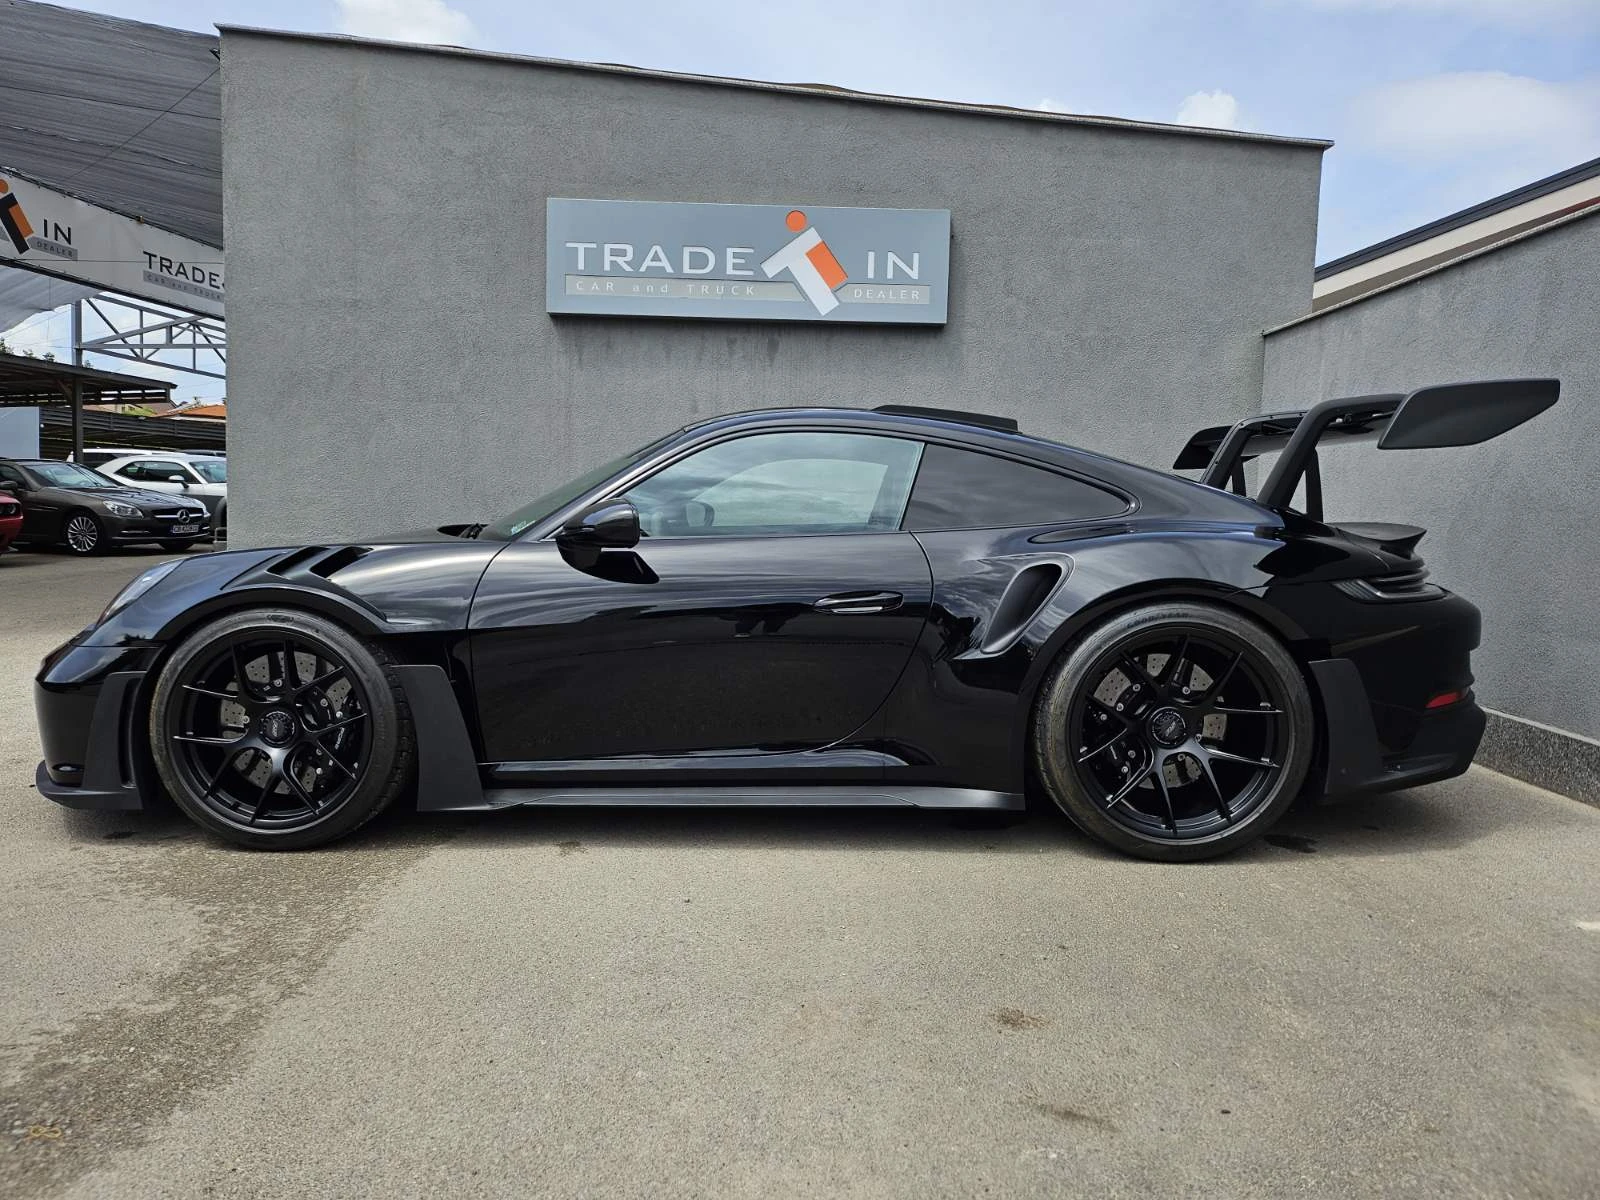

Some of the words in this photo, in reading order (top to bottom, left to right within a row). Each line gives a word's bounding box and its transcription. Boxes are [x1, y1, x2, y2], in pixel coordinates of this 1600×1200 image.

[43, 219, 72, 245] IN
[36, 241, 74, 258] DEALER
[566, 242, 754, 275] TRADE
[867, 251, 920, 279] IN
[143, 251, 221, 289] TRADE
[575, 281, 616, 292] CAR
[632, 284, 669, 294] and
[687, 284, 755, 297] TRUCK
[854, 288, 921, 301] DEALER
